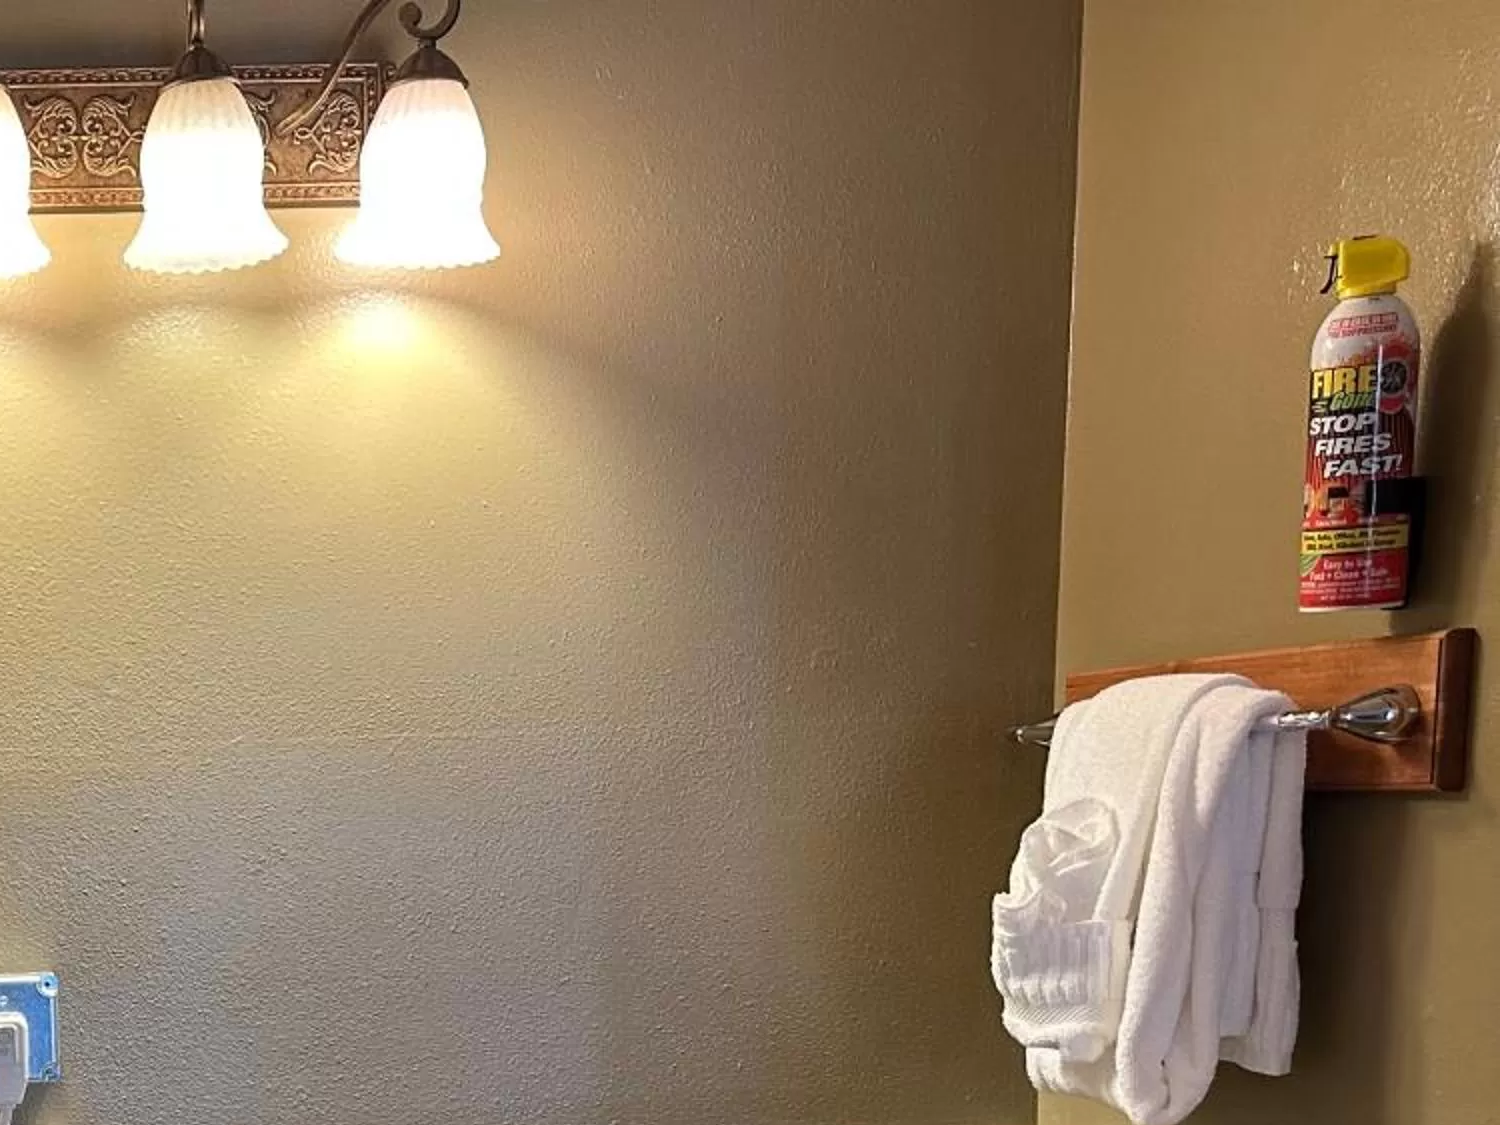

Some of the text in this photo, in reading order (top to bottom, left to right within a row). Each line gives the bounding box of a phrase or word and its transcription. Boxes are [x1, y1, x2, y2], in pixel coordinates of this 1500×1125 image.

[1311, 365, 1378, 399] FIRE
[1309, 412, 1378, 435] STOP
[1315, 433, 1391, 457] FIRES
[1323, 453, 1403, 479] FAST!
